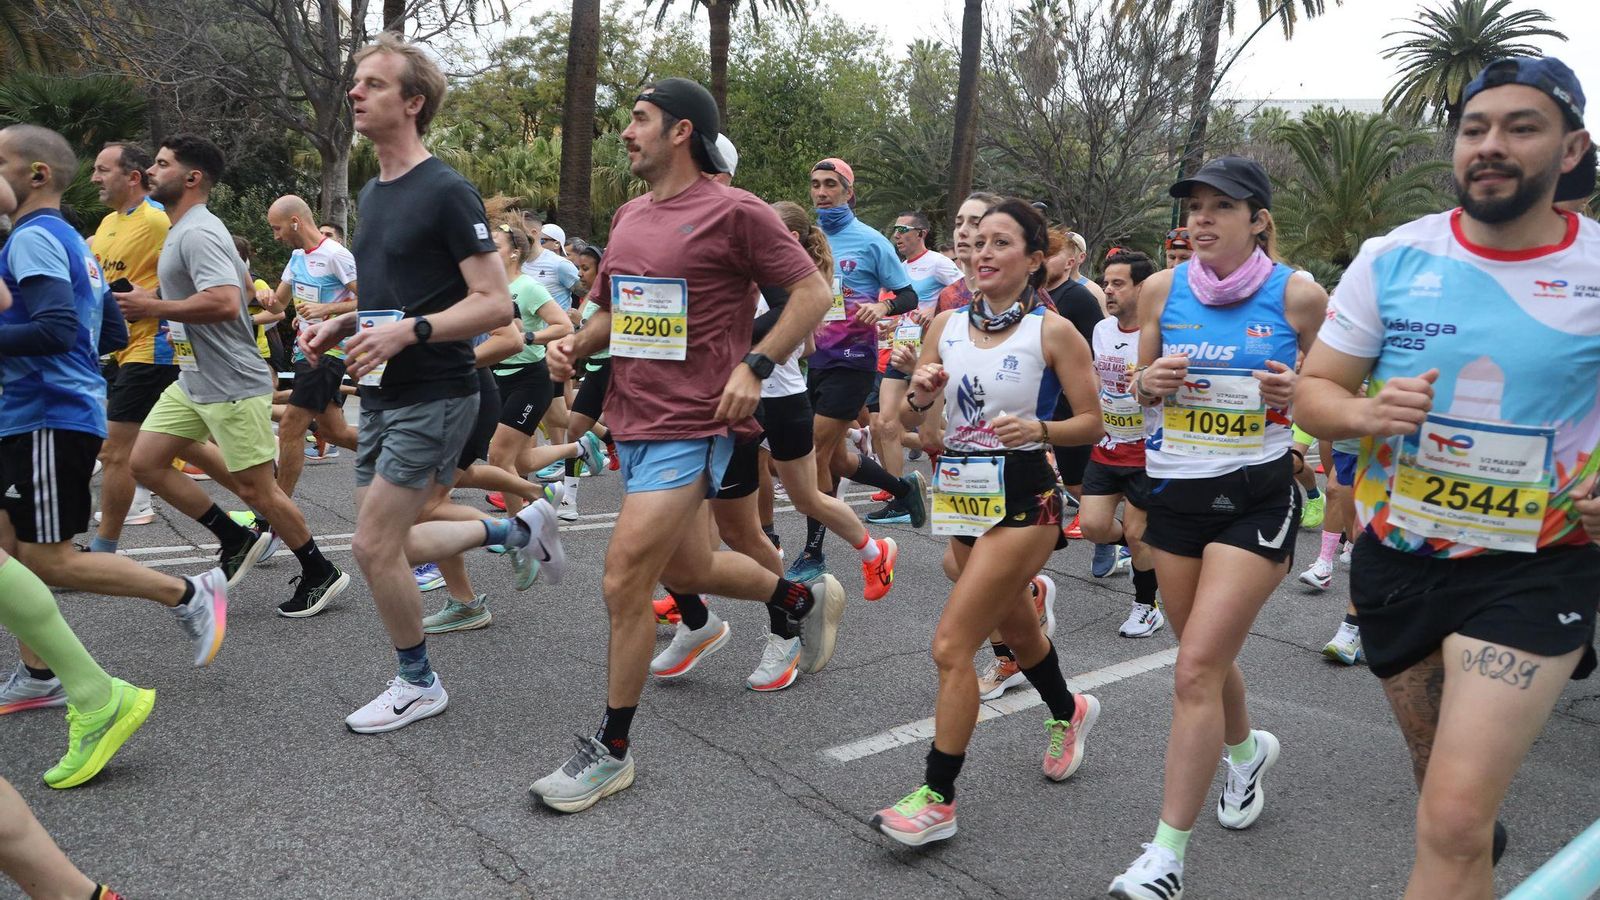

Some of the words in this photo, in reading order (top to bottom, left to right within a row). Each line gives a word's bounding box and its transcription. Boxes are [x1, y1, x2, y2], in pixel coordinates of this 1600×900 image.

[622, 316, 671, 337] 2290
[1104, 413, 1134, 427] 3501
[1186, 410, 1247, 436] 1094
[1425, 453, 1472, 468] TotalEnergies
[950, 496, 990, 517] 1107
[1422, 476, 1520, 518] 2544
